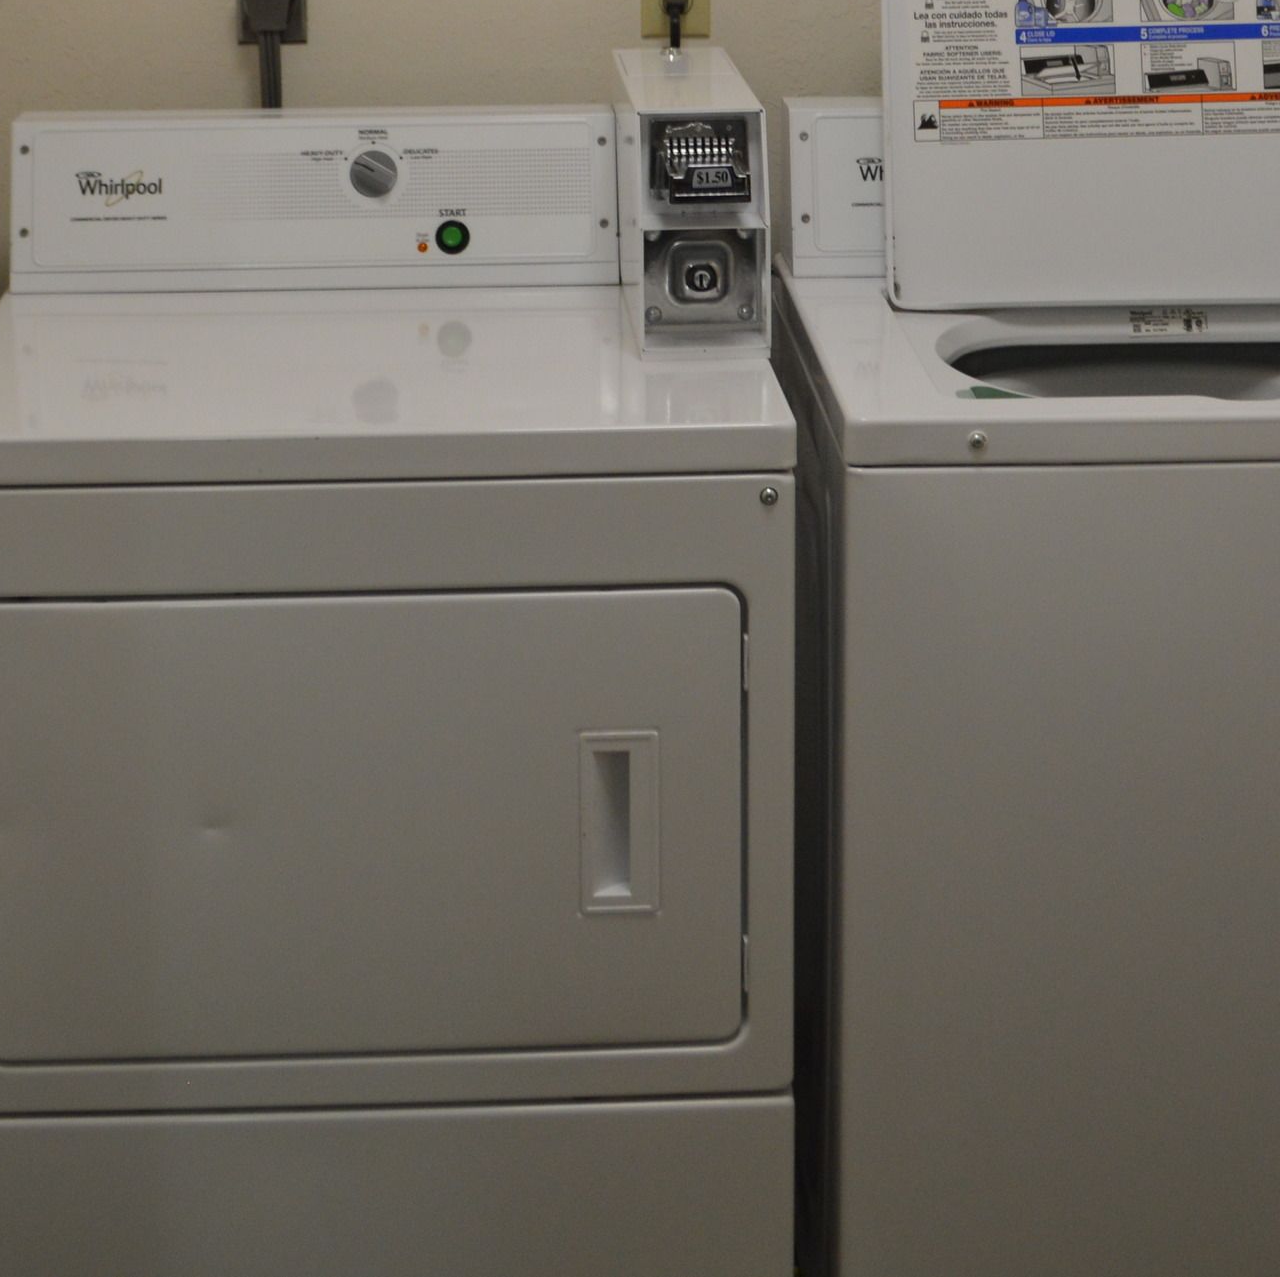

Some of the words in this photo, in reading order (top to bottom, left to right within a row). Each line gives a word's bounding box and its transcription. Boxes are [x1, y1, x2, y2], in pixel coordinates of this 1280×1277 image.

[913, 11, 929, 20] Lea
[931, 12, 947, 20] con
[949, 11, 982, 20] cuidado
[984, 10, 1008, 19] todas
[925, 21, 937, 29] las
[939, 20, 998, 28] instrucciones.
[1140, 28, 1148, 40] 5
[1261, 25, 1269, 37] 6
[1019, 31, 1026, 43] 4
[976, 99, 1014, 108] WARNING
[1093, 95, 1159, 105] AVERTISSEMENT
[696, 170, 729, 185] $1.50
[78, 178, 163, 200] Whirlpool
[438, 208, 467, 217] START
